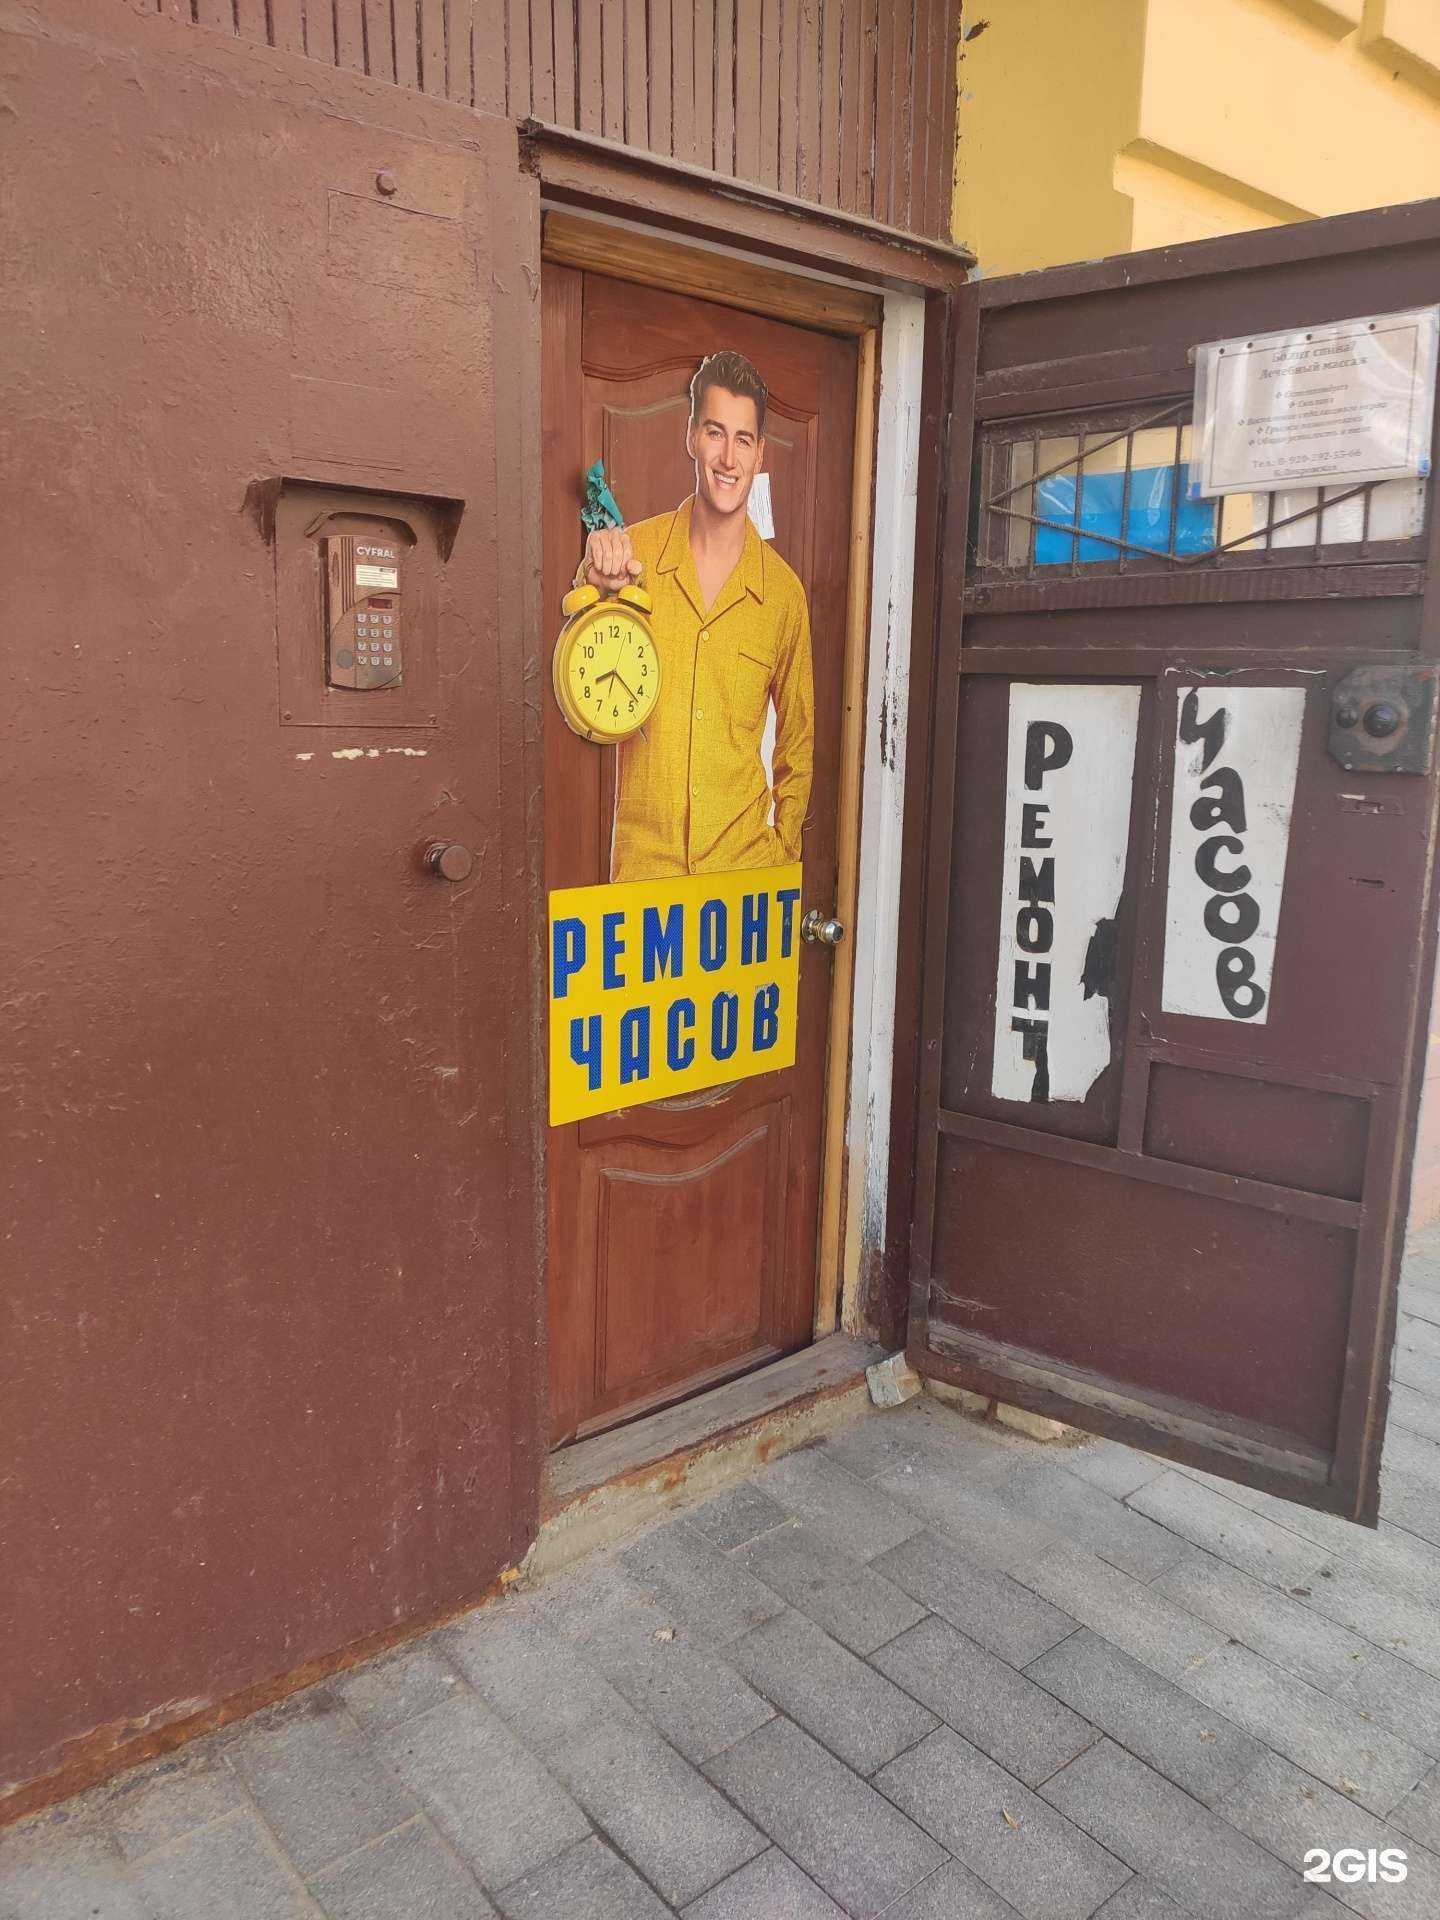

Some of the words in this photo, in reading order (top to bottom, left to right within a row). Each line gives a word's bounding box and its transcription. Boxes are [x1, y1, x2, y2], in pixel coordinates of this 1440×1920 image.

[356, 546, 395, 559] CYFRAL
[594, 631, 603, 644] 11
[609, 626, 620, 638] 12
[583, 646, 594, 659] 10
[637, 646, 644, 658] 2
[579, 667, 585, 679] 9
[641, 665, 648, 677] 3
[584, 686, 591, 698] 8
[637, 685, 644, 696] 4
[596, 700, 602, 711] 7
[612, 706, 619, 717] 6
[628, 701, 634, 712] 5
[1011, 720, 1074, 1102] РЕМОНТ
[552, 888, 800, 999] РЕМОНТ
[570, 982, 780, 1091] ЧАСОВ
